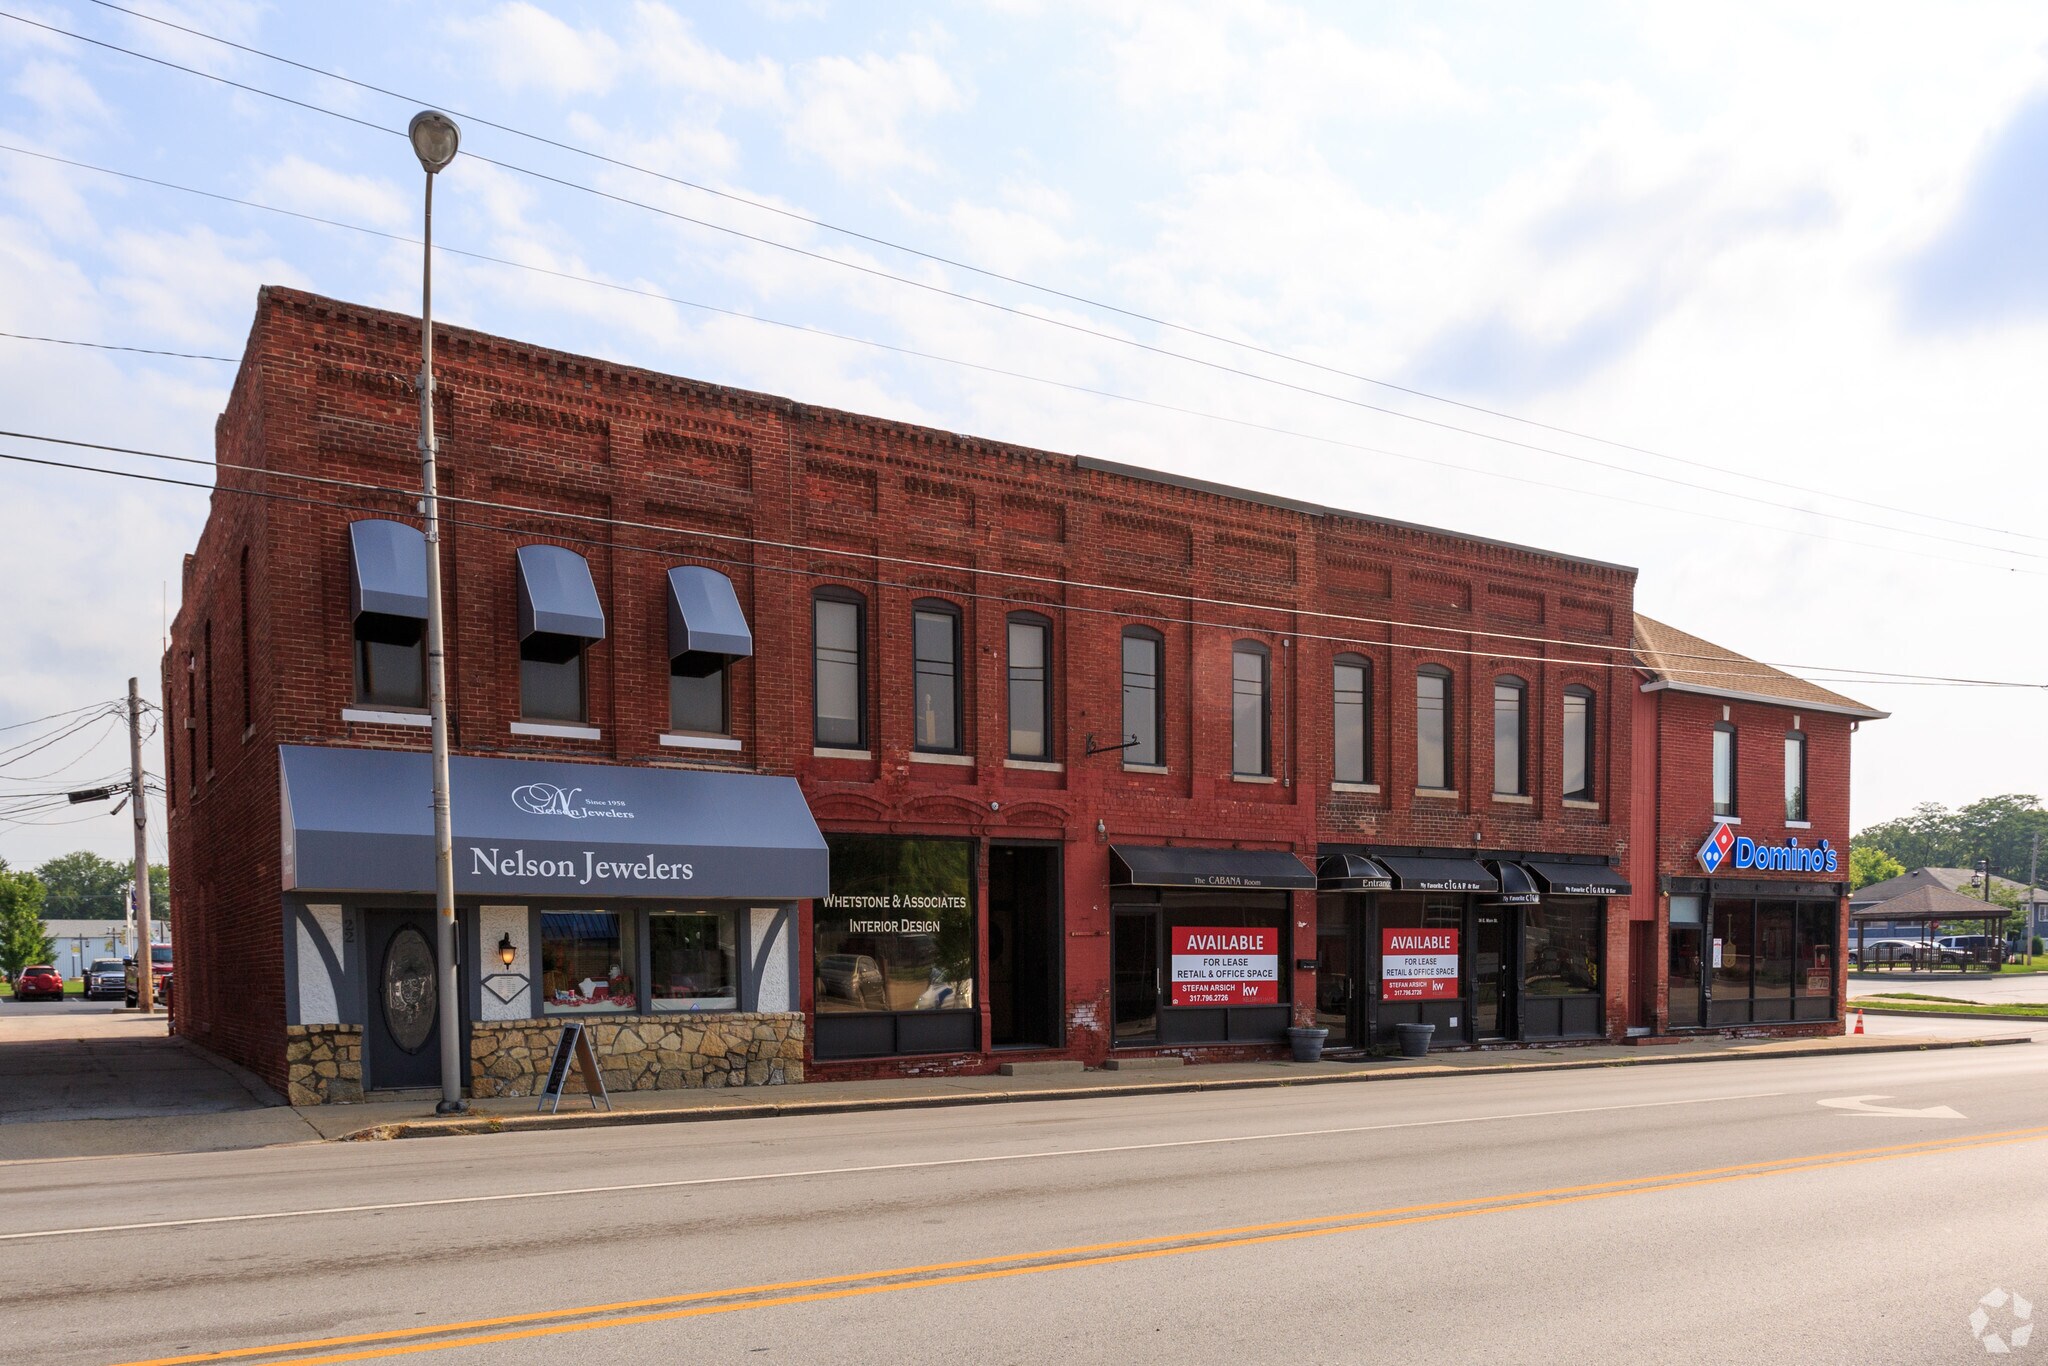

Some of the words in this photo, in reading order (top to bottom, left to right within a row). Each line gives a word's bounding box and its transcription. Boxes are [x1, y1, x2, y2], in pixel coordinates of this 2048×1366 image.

[585, 798, 606, 806] Since
[533, 805, 579, 816] Nelson
[580, 807, 635, 819] Jewelers
[1735, 836, 1838, 873] Domino's
[470, 847, 576, 877] Nelson
[579, 851, 694, 885] Jewelers
[1208, 875, 1241, 885] CABANA
[1243, 878, 1261, 886] Room
[823, 893, 890, 908] WHETSTONE
[892, 894, 901, 908] &
[903, 894, 967, 908] ASSOCIATES
[849, 918, 899, 933] INTERIOR
[901, 918, 940, 933] DESIGN
[1187, 935, 1264, 950] AVAILABLE
[1390, 936, 1451, 949] AVAILABLE
[1203, 958, 1220, 967] FOR
[1222, 958, 1249, 966] LEASE
[1404, 958, 1417, 966] FOR
[1418, 957, 1437, 965] LEASE
[1177, 970, 1206, 979] RETAIL
[1208, 970, 1214, 978] &
[1216, 969, 1245, 978] OFFICE
[1247, 969, 1273, 978] SPACE
[1386, 968, 1407, 976] RETAIL
[1408, 968, 1412, 976] &
[1413, 968, 1434, 976] OFFICE
[1435, 967, 1455, 975] SPACE
[1182, 984, 1209, 992] STEFAN
[1242, 982, 1259, 996] kw
[1432, 980, 1444, 991] kw
